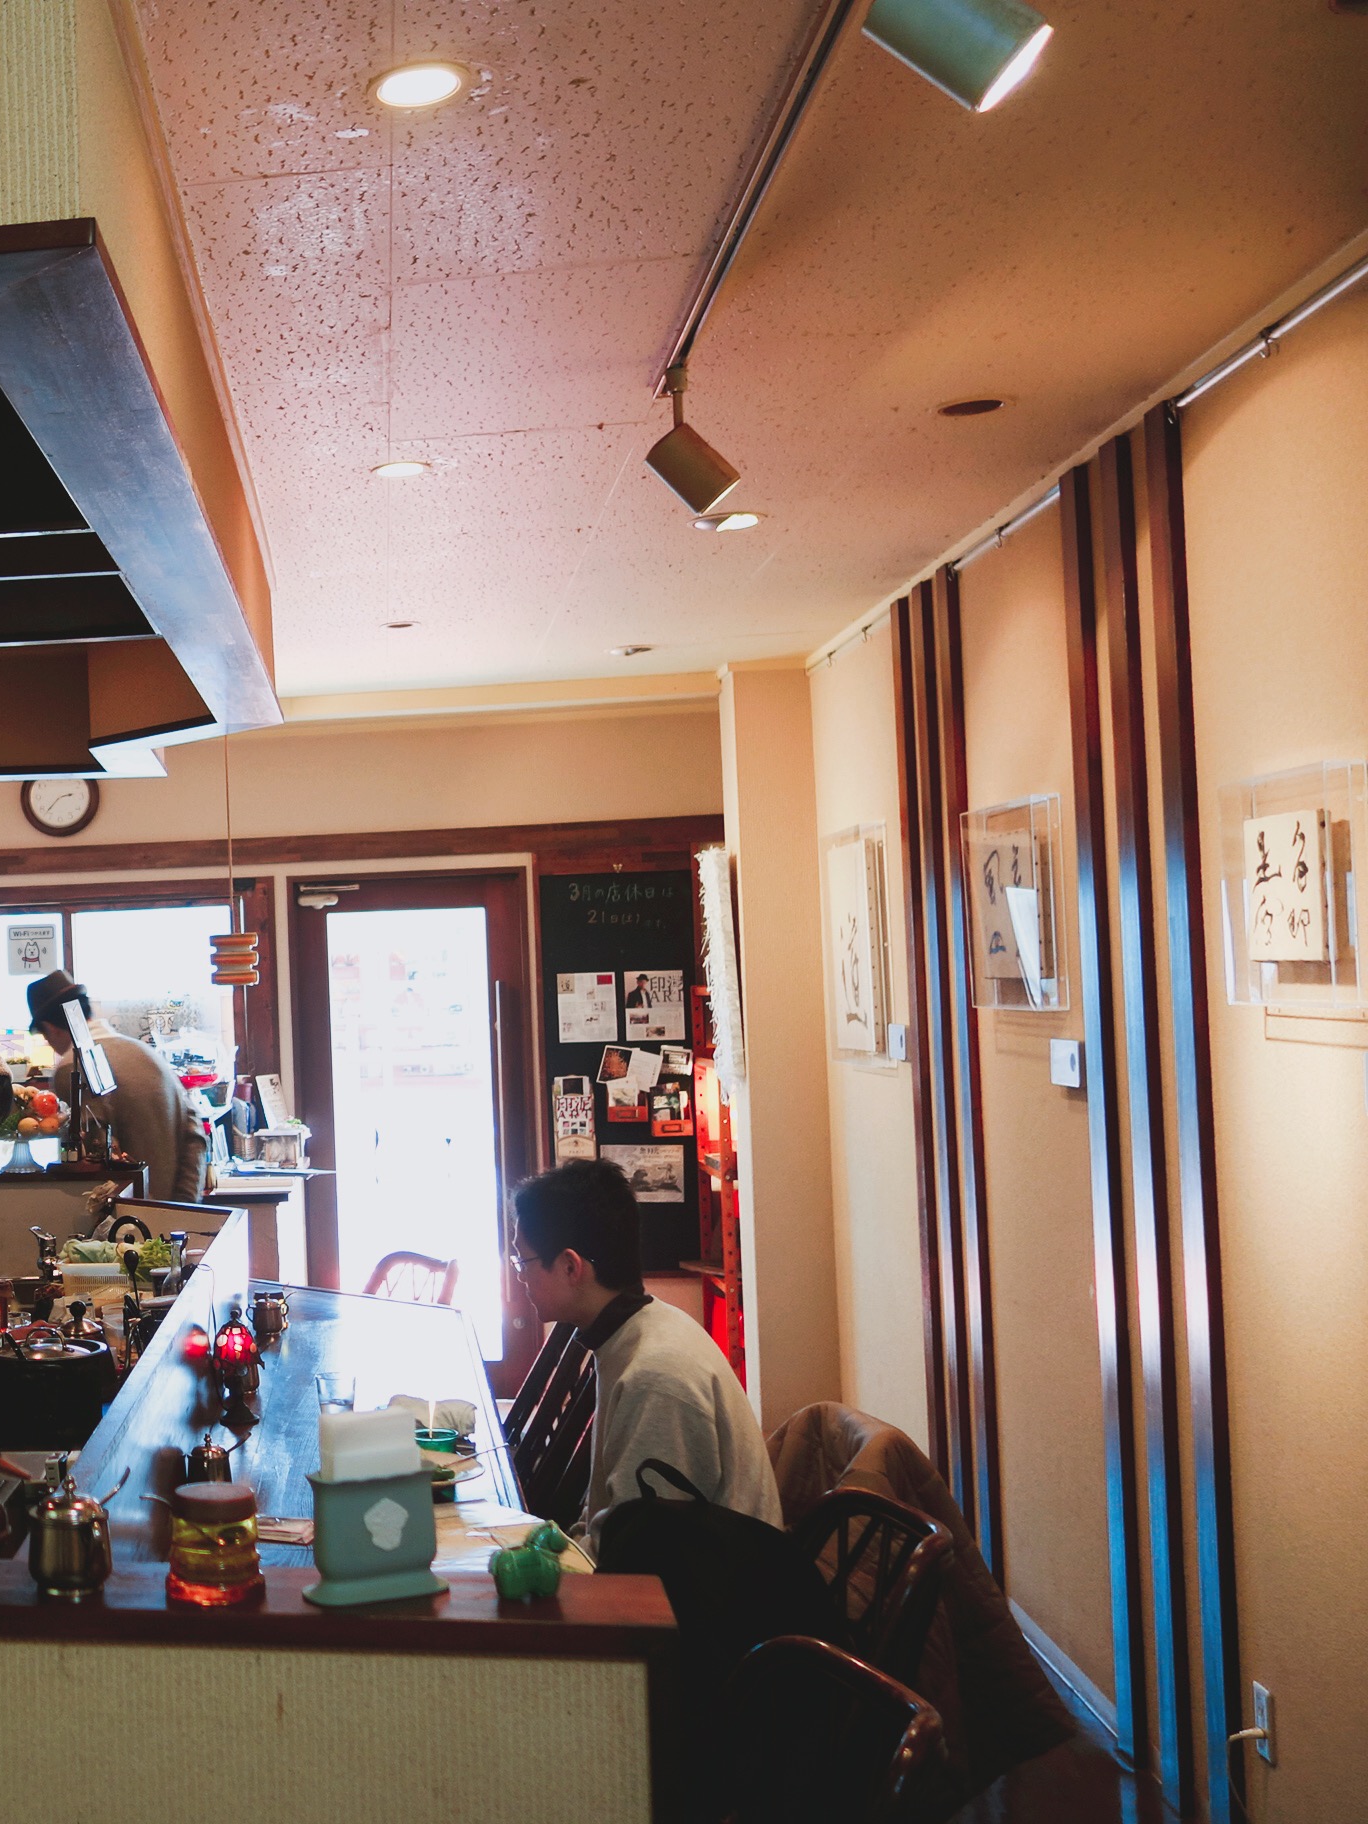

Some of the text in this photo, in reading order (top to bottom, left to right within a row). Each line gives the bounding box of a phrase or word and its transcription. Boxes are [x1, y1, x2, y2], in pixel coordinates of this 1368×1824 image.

[568, 880, 674, 903] 3月の店休日は
